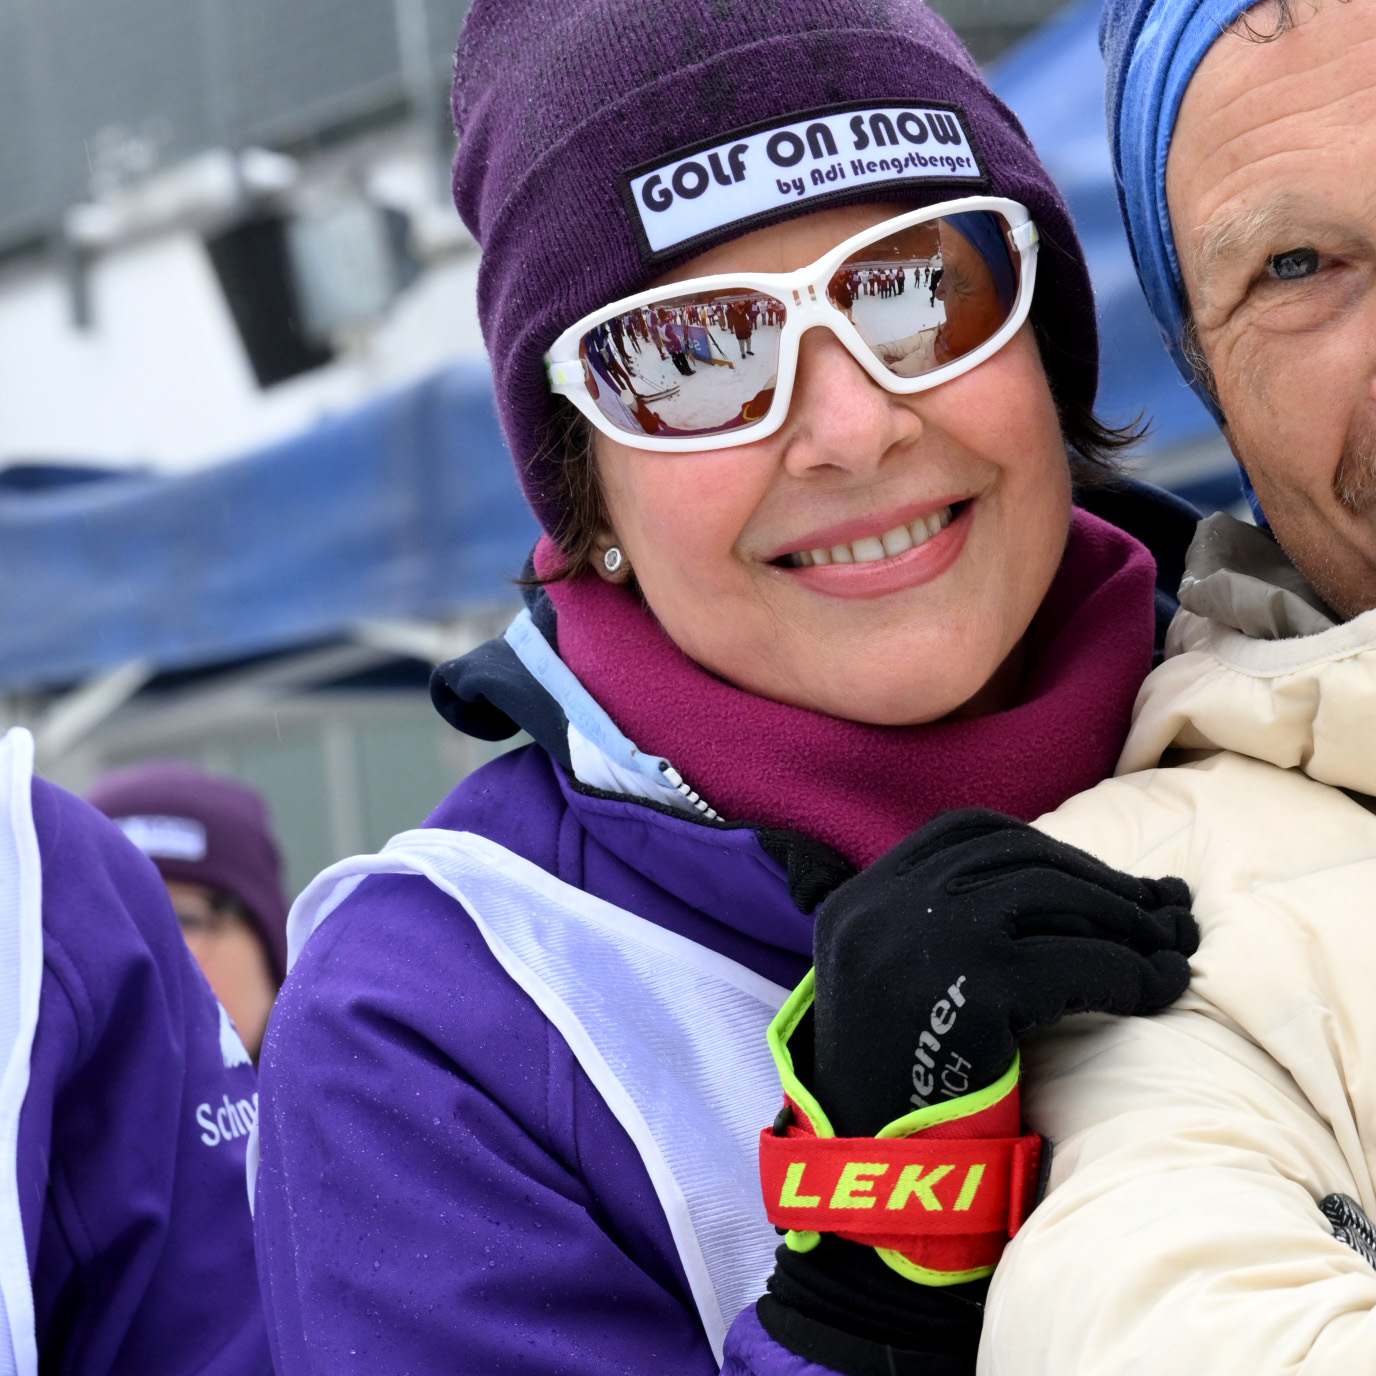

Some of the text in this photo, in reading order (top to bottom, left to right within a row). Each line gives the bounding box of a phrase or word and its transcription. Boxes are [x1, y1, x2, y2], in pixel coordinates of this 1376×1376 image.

[641, 111, 963, 212] GOLF ON SNOW
[776, 150, 972, 195] by Adi Hengstberger
[910, 975, 967, 1110] iener
[940, 1051, 972, 1098] ICH
[779, 1161, 987, 1212] LEKI
